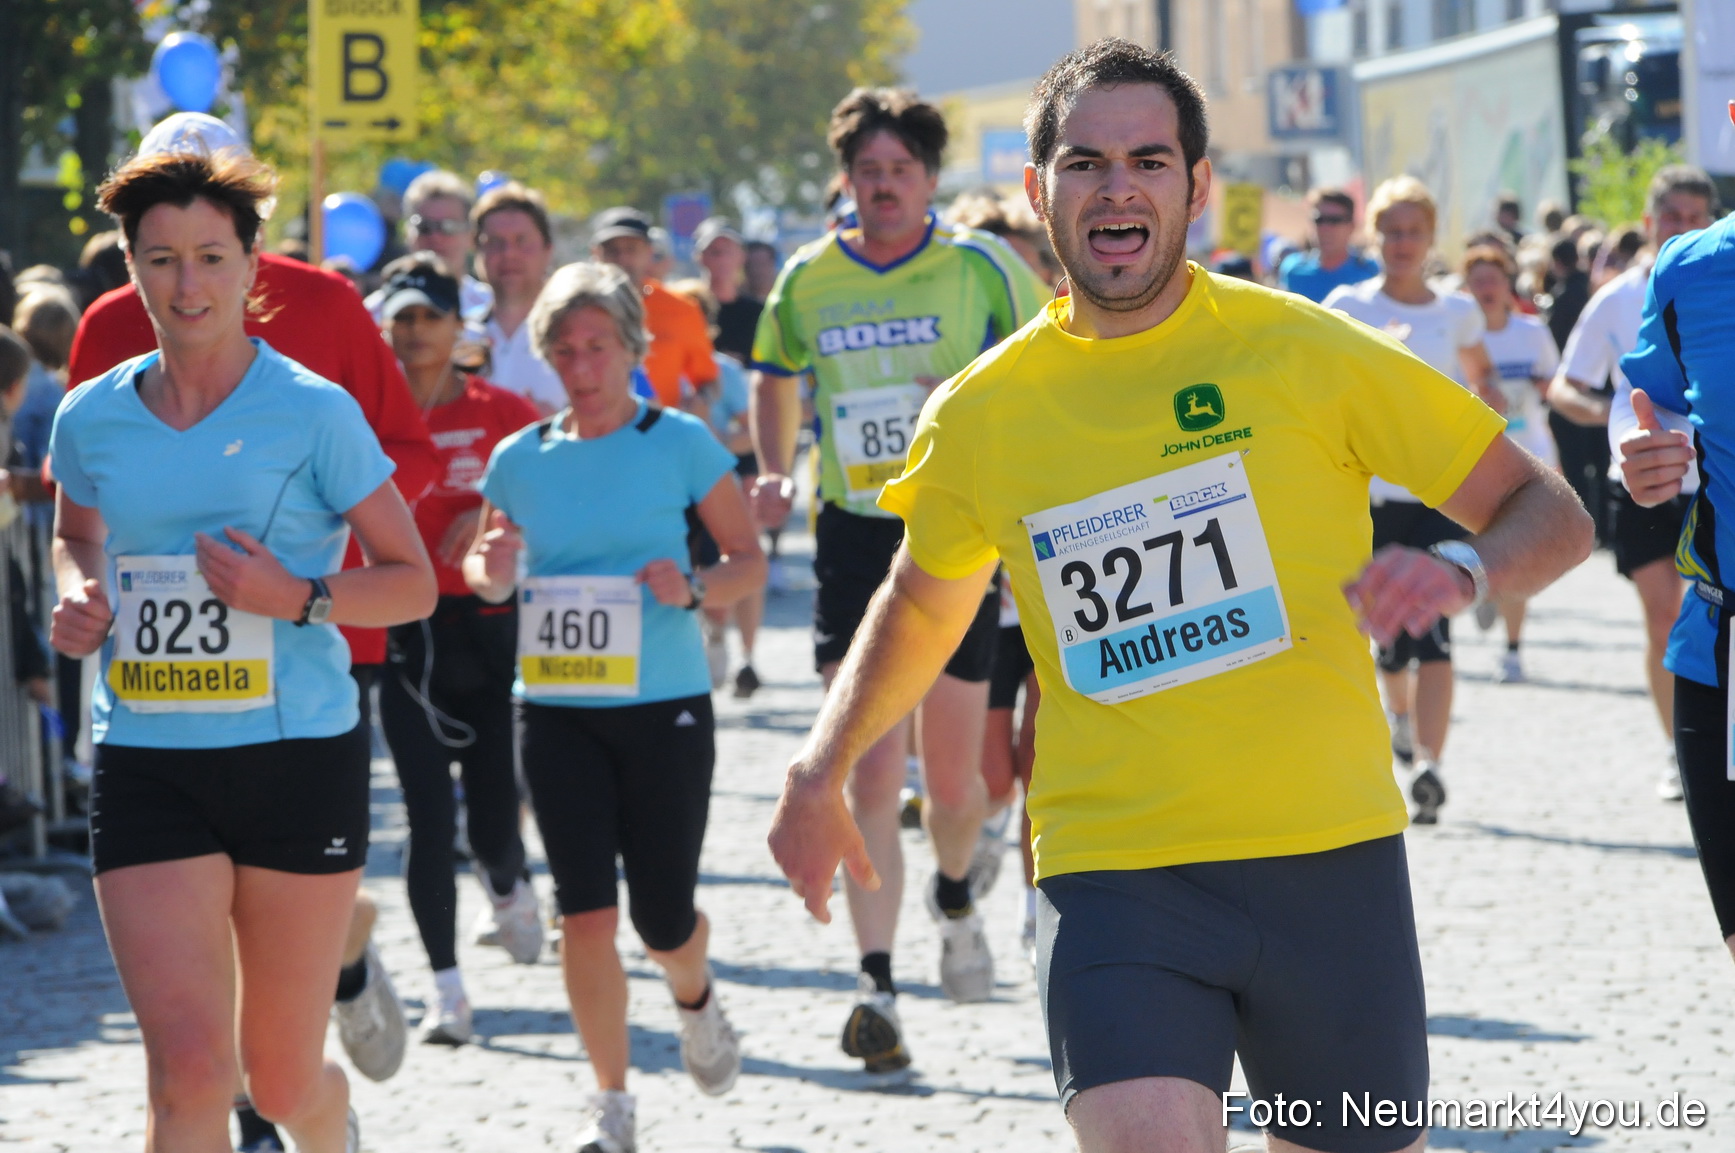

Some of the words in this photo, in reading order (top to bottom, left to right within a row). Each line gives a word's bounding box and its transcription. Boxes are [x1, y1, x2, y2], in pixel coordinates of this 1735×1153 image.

[343, 33, 388, 101] B
[817, 316, 942, 357] BOCK
[860, 413, 920, 458] 85
[1160, 440, 1200, 457] JOHN
[1202, 427, 1253, 448] DEERE
[1169, 482, 1228, 511] BOCK
[1052, 503, 1147, 544] PFLEIDERER
[1058, 521, 1151, 556] AKTIENGESELLSCHAFT
[1060, 517, 1238, 632] 3271
[136, 599, 229, 655] 823
[538, 609, 608, 650] 460
[1065, 629, 1074, 642] B
[1099, 607, 1250, 679] Andreas
[122, 663, 249, 692] Michaela
[540, 656, 606, 678] Nicola
